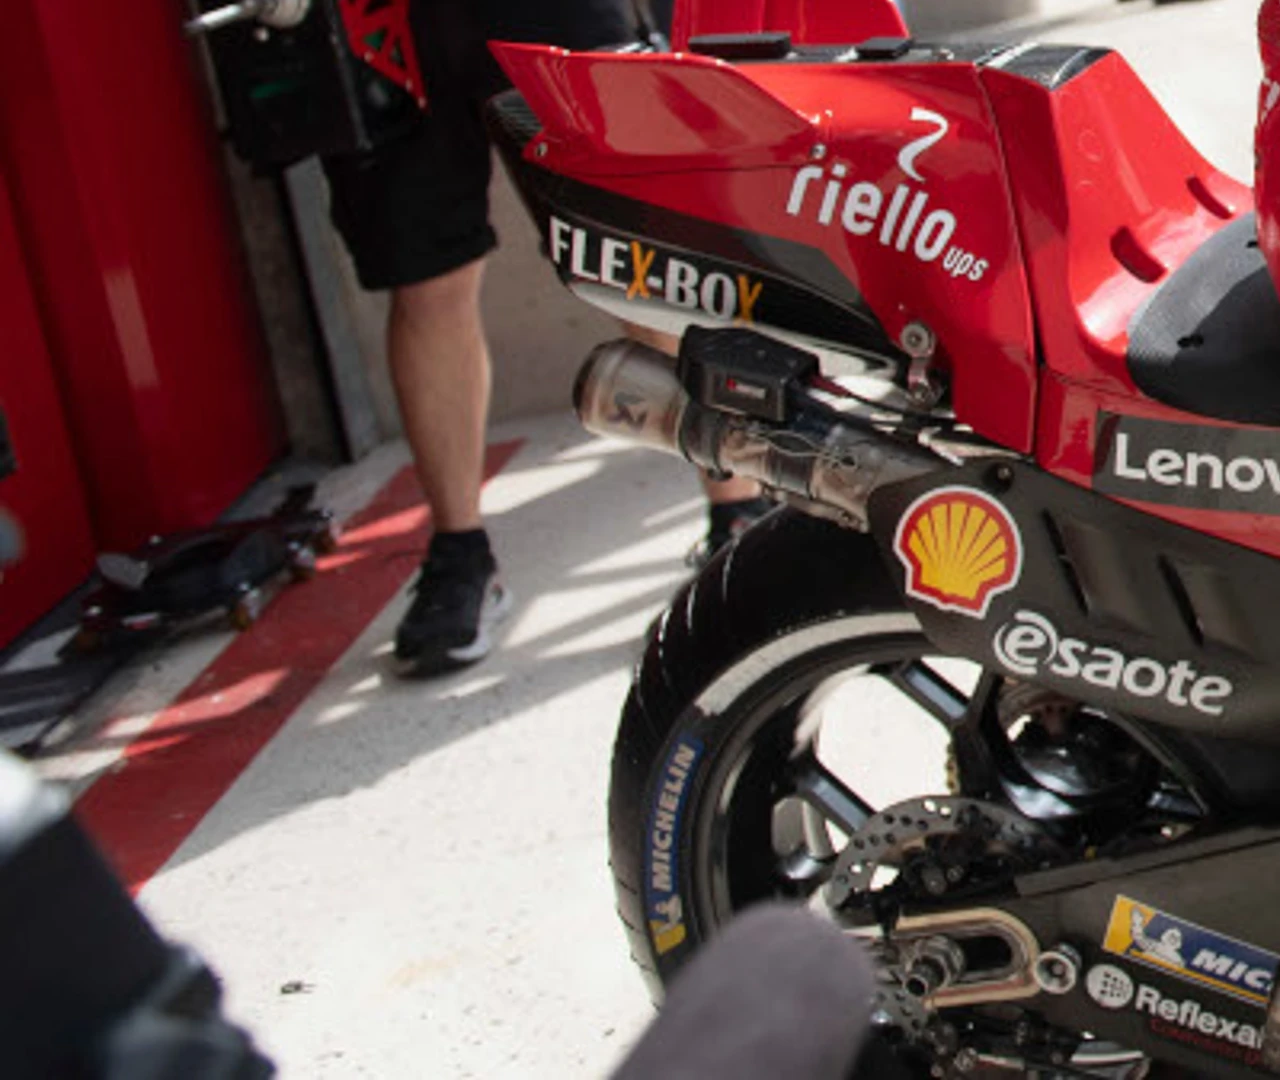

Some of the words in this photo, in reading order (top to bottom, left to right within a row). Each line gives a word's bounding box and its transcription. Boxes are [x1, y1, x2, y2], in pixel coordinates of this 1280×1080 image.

[548, 214, 763, 325] FLEX-BOX
[784, 161, 958, 263] riello
[943, 244, 990, 283] ups
[993, 611, 1234, 716] esaote
[649, 742, 697, 894] MICHELIN
